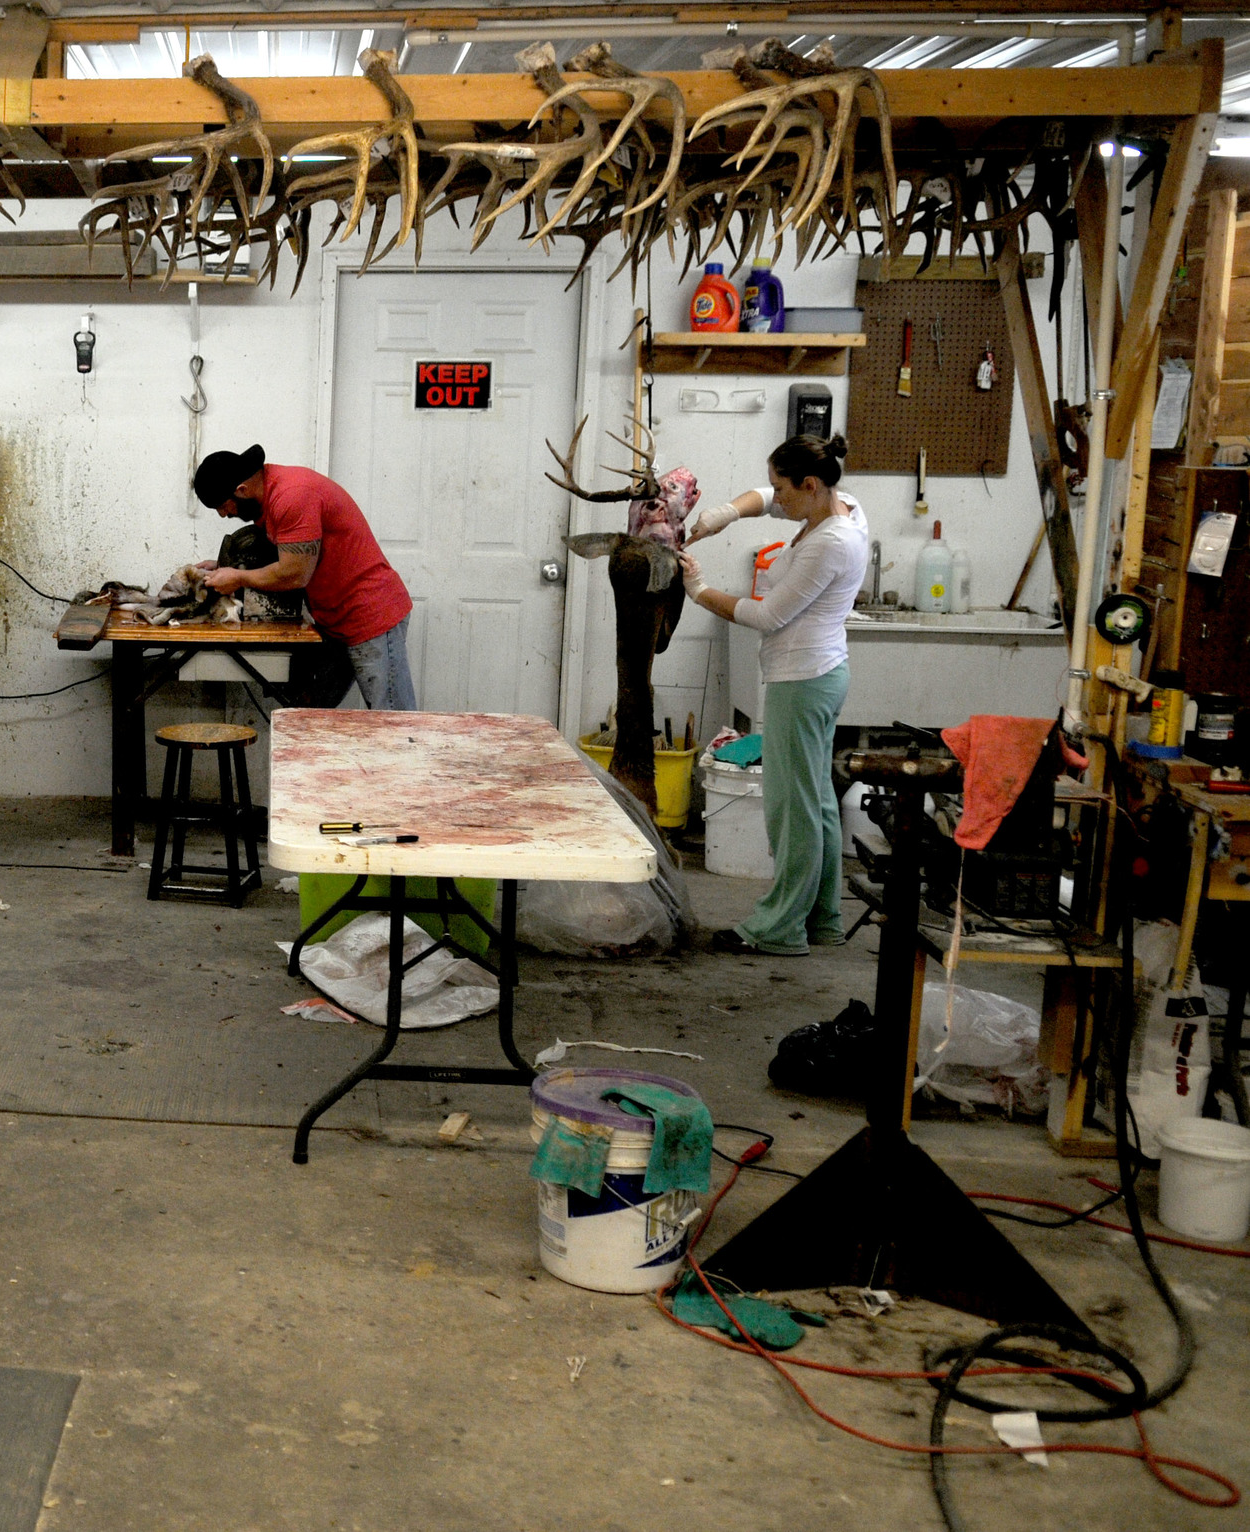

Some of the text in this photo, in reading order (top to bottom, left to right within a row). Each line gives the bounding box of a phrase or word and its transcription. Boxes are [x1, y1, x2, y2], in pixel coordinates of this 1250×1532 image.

[696, 297, 713, 313] Tide
[419, 364, 488, 383] KEEP
[426, 386, 480, 406] OUT
[646, 1234, 669, 1252] ALL
